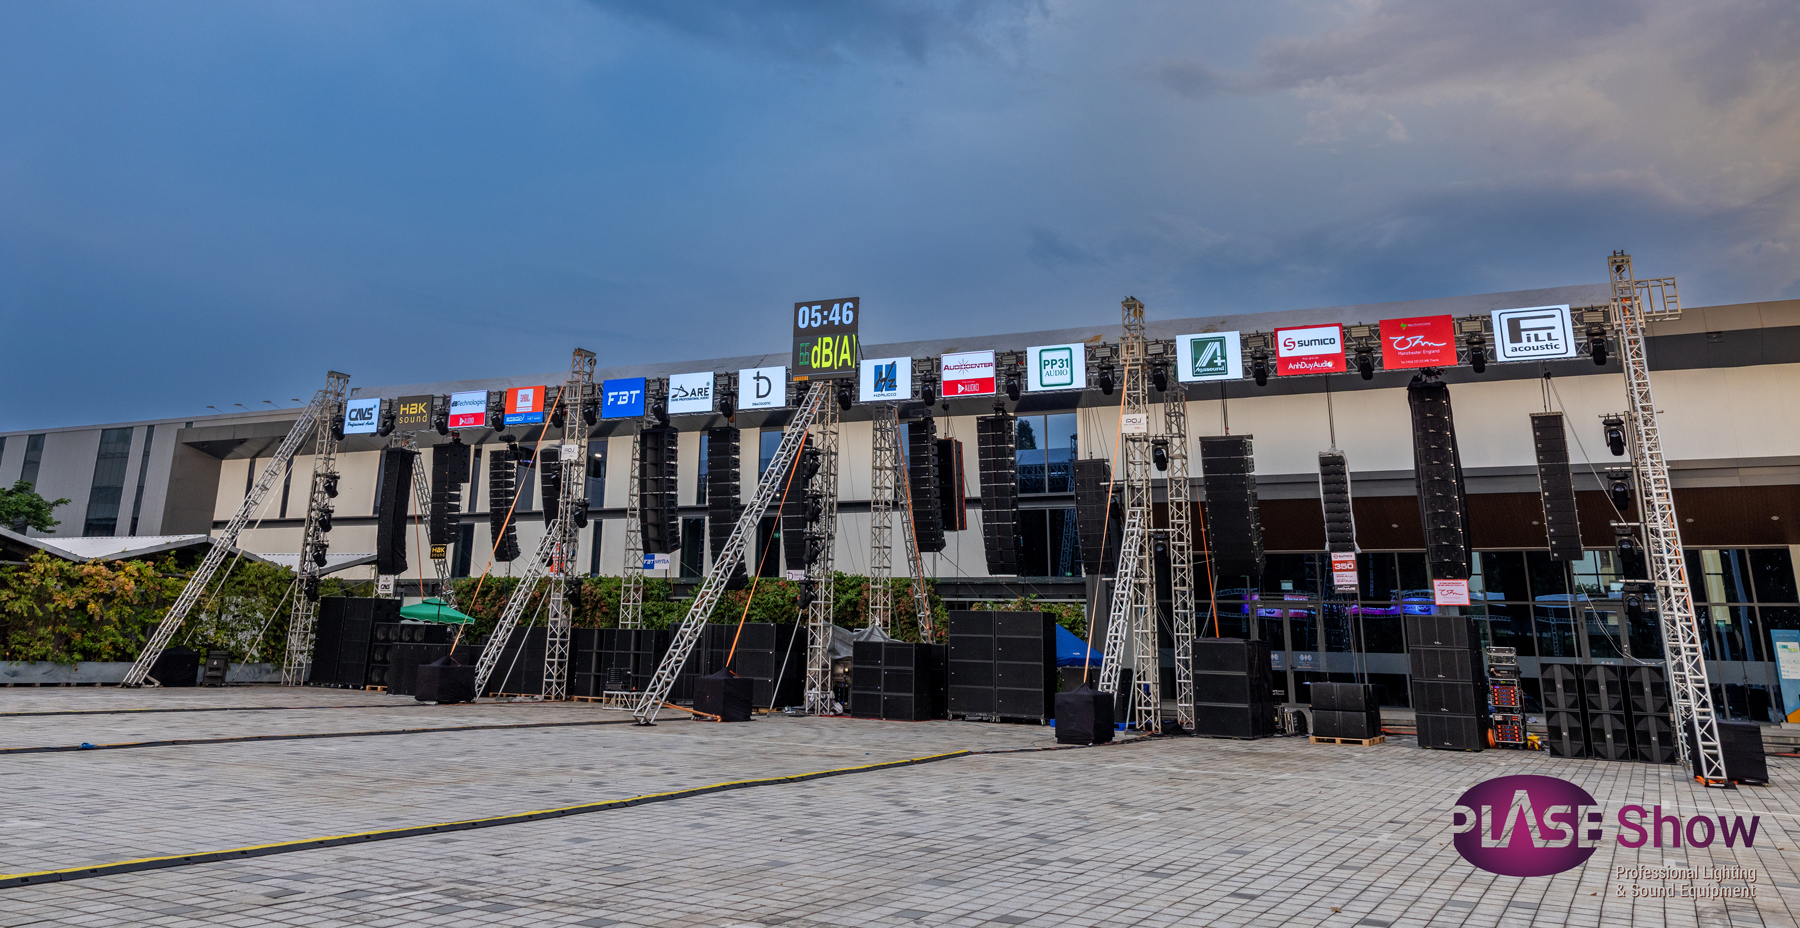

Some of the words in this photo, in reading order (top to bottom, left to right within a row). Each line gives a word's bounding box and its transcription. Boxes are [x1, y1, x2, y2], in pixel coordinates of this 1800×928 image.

[798, 302, 854, 329] 05:46
[811, 334, 856, 370] dB(A)
[1511, 343, 1560, 352] acoustic
[1043, 358, 1069, 370] PP31
[1044, 369, 1068, 377] AUDIO
[607, 390, 640, 405] FBT
[400, 402, 427, 415] HBK
[399, 413, 428, 424] sound
